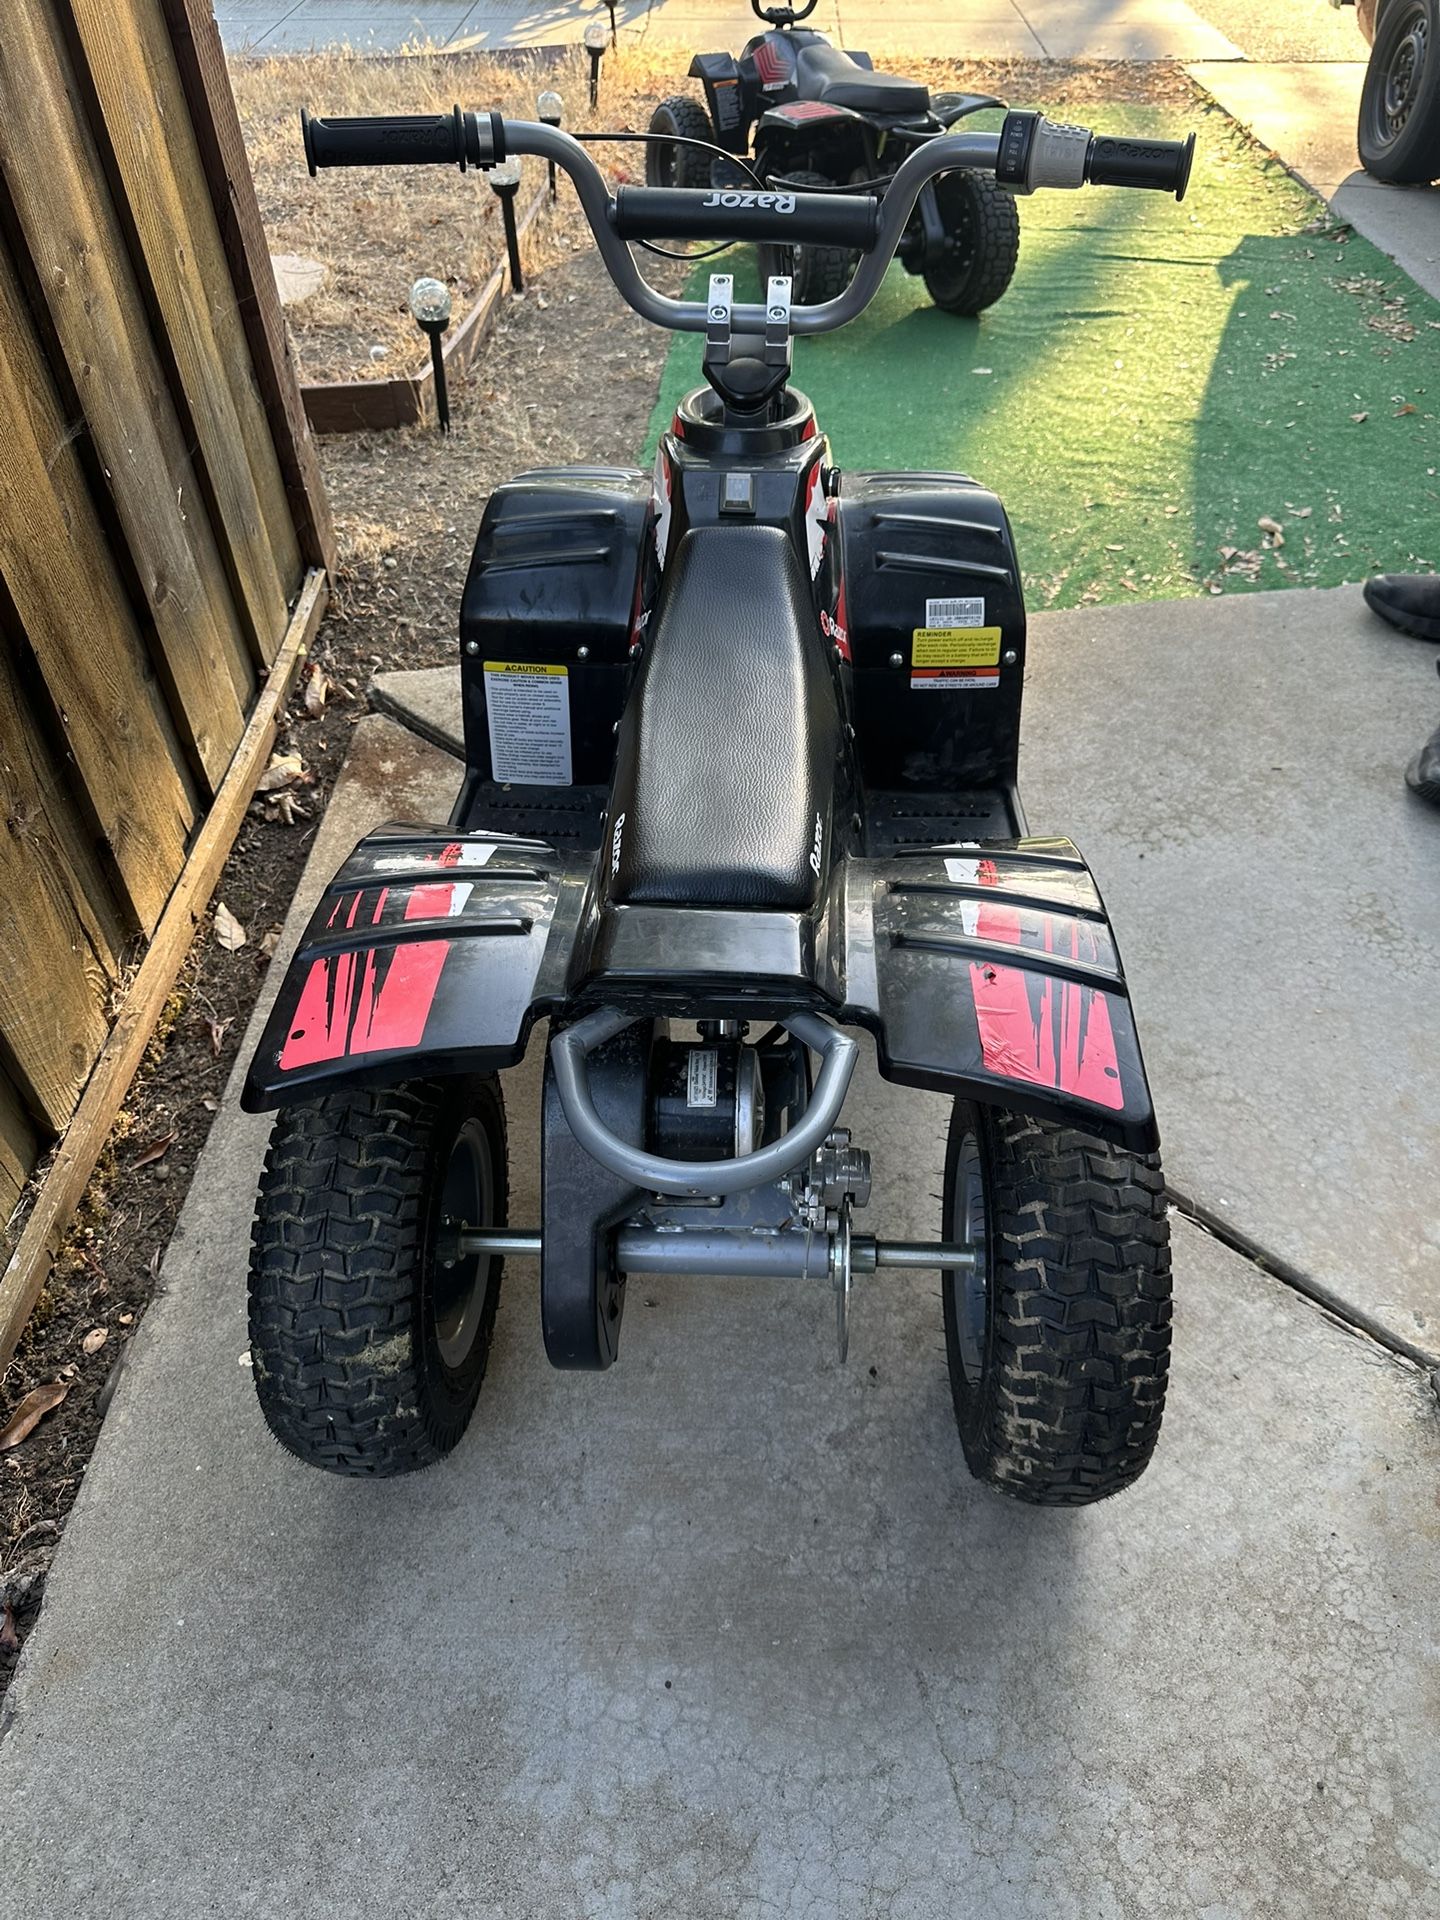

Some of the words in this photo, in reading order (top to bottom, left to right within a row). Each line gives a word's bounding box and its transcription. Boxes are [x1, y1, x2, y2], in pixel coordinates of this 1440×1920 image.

[703, 193, 796, 213] Razor
[511, 665, 547, 673] CAUTION
[810, 812, 823, 878] Razor
